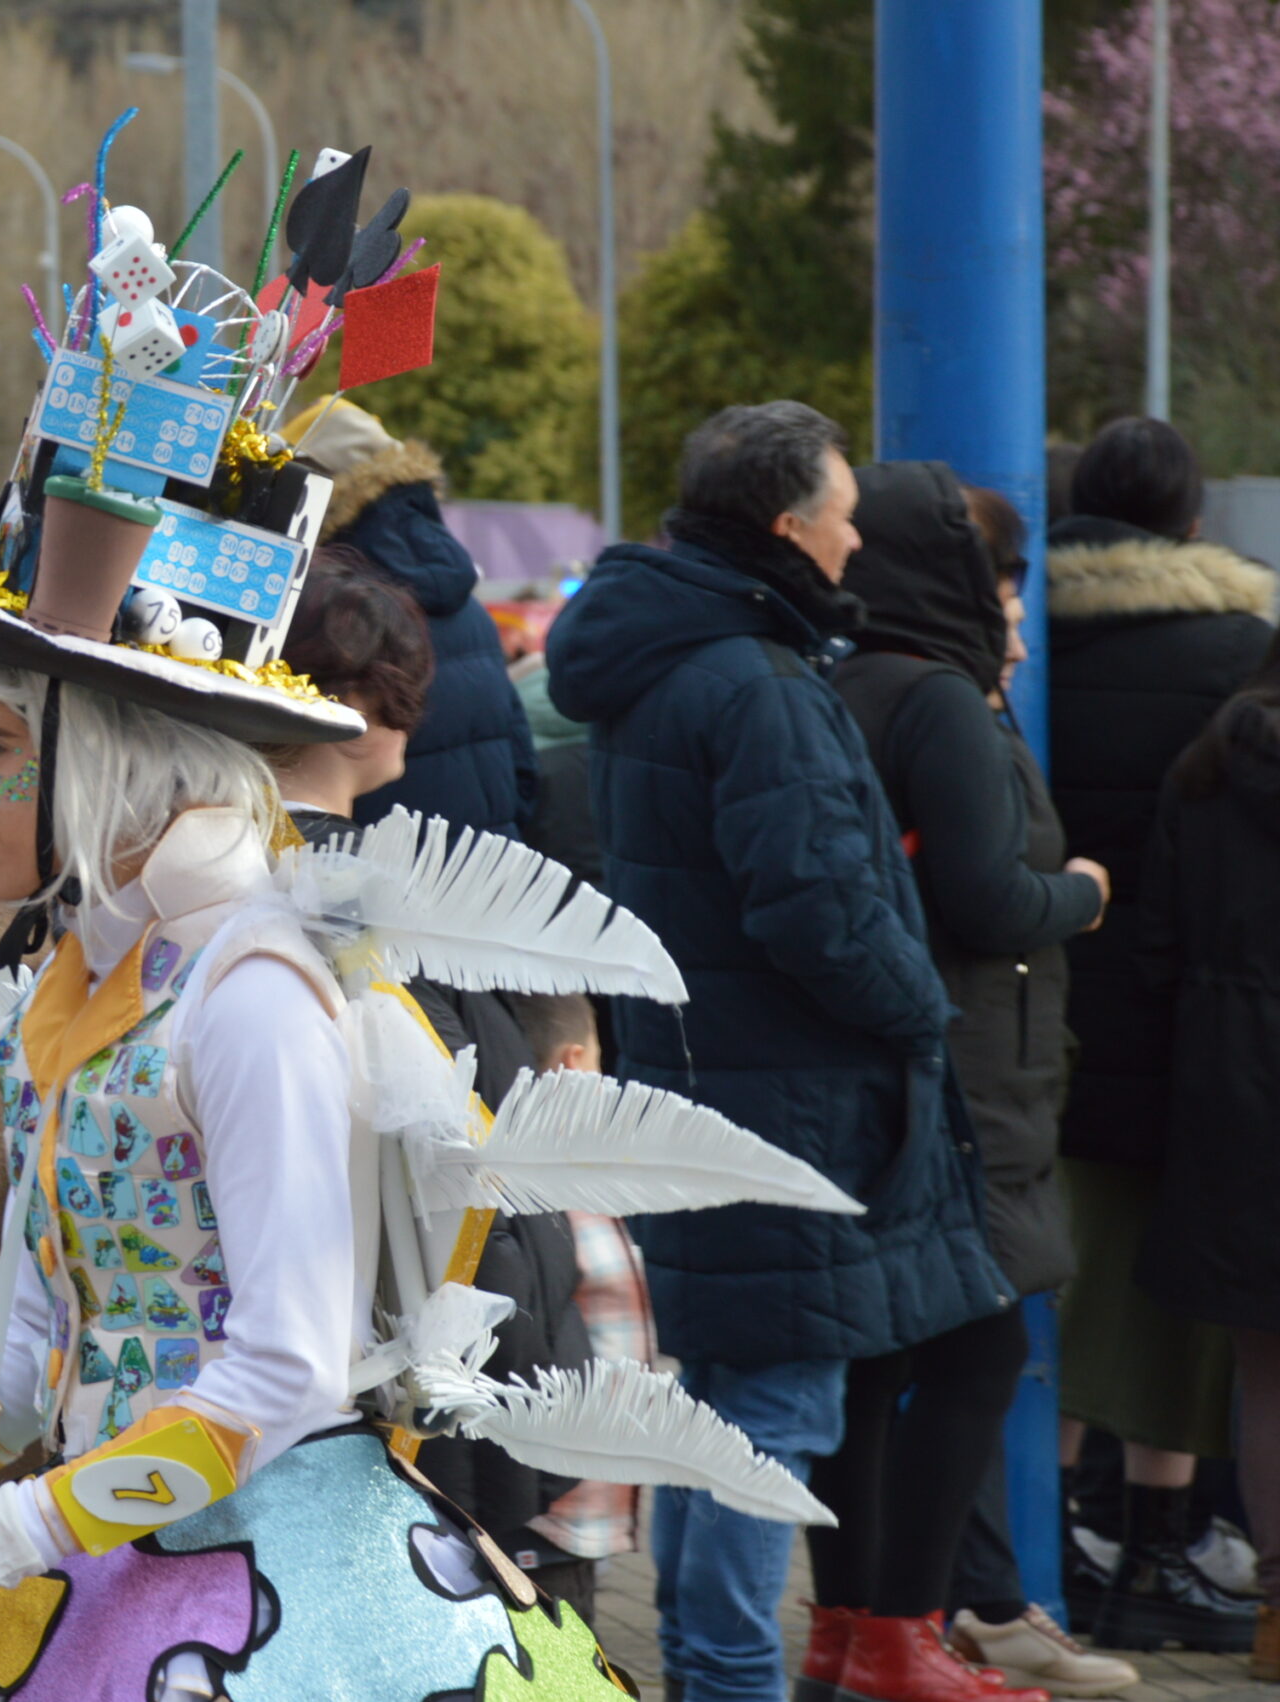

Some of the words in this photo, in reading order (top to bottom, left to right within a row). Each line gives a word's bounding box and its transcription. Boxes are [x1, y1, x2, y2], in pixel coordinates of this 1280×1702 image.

[61, 352, 93, 367] BINGO
[94, 361, 128, 377] LTO
[71, 397, 84, 410] 18
[162, 424, 176, 436] 65
[181, 429, 195, 442] 77
[114, 385, 128, 397] 36
[189, 407, 202, 420] 74
[206, 412, 220, 425] 84
[119, 435, 133, 448] 44
[155, 447, 170, 458] 60
[193, 457, 207, 470] 88
[222, 537, 236, 549] 50
[239, 544, 253, 556] 64
[257, 550, 272, 562] 77
[215, 560, 229, 571] 54
[232, 566, 246, 578] 67
[268, 578, 282, 590] 80
[191, 577, 204, 588] 40
[243, 594, 257, 606] 73
[111, 1470, 176, 1505] 7
